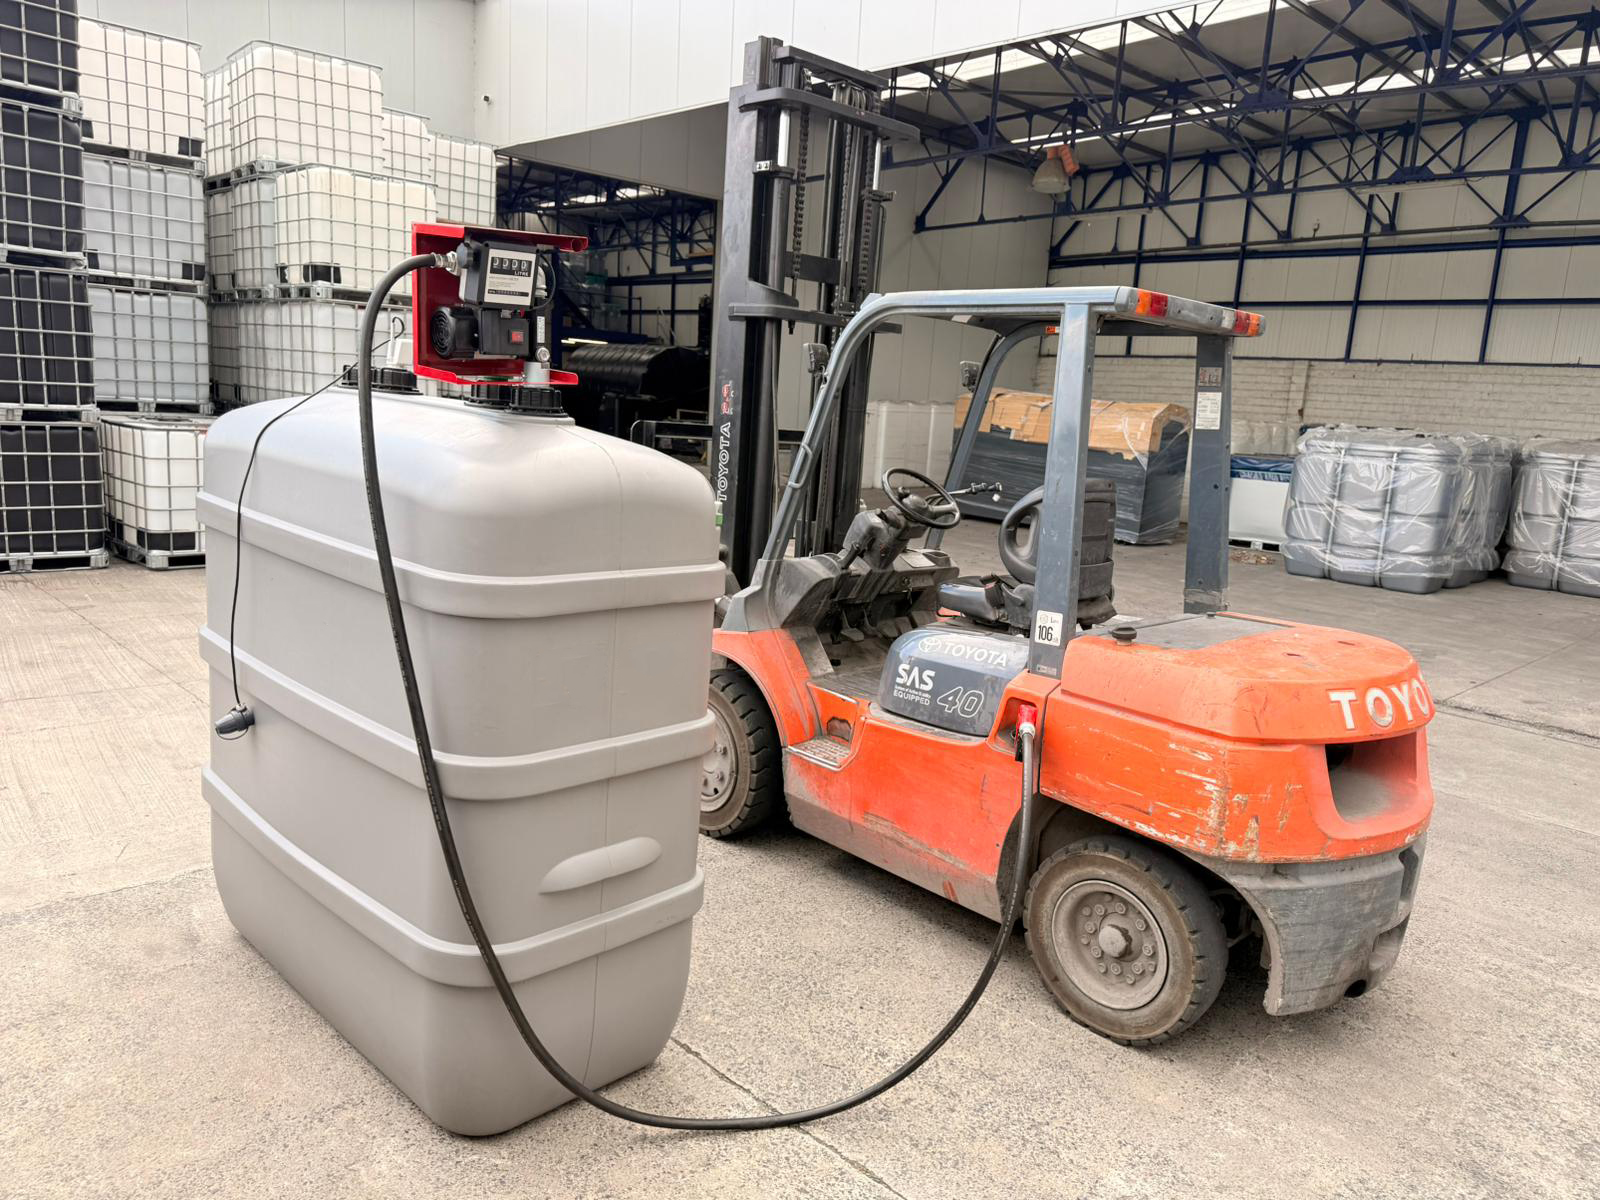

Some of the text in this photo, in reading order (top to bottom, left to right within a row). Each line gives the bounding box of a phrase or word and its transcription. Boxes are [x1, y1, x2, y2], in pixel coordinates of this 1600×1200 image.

[717, 421, 731, 502] TOYOTA
[1037, 624, 1054, 641] 106
[941, 642, 1008, 667] TOYOTA
[895, 663, 936, 691] SAS
[893, 689, 931, 706] EQUIPPED
[937, 686, 985, 718] 40
